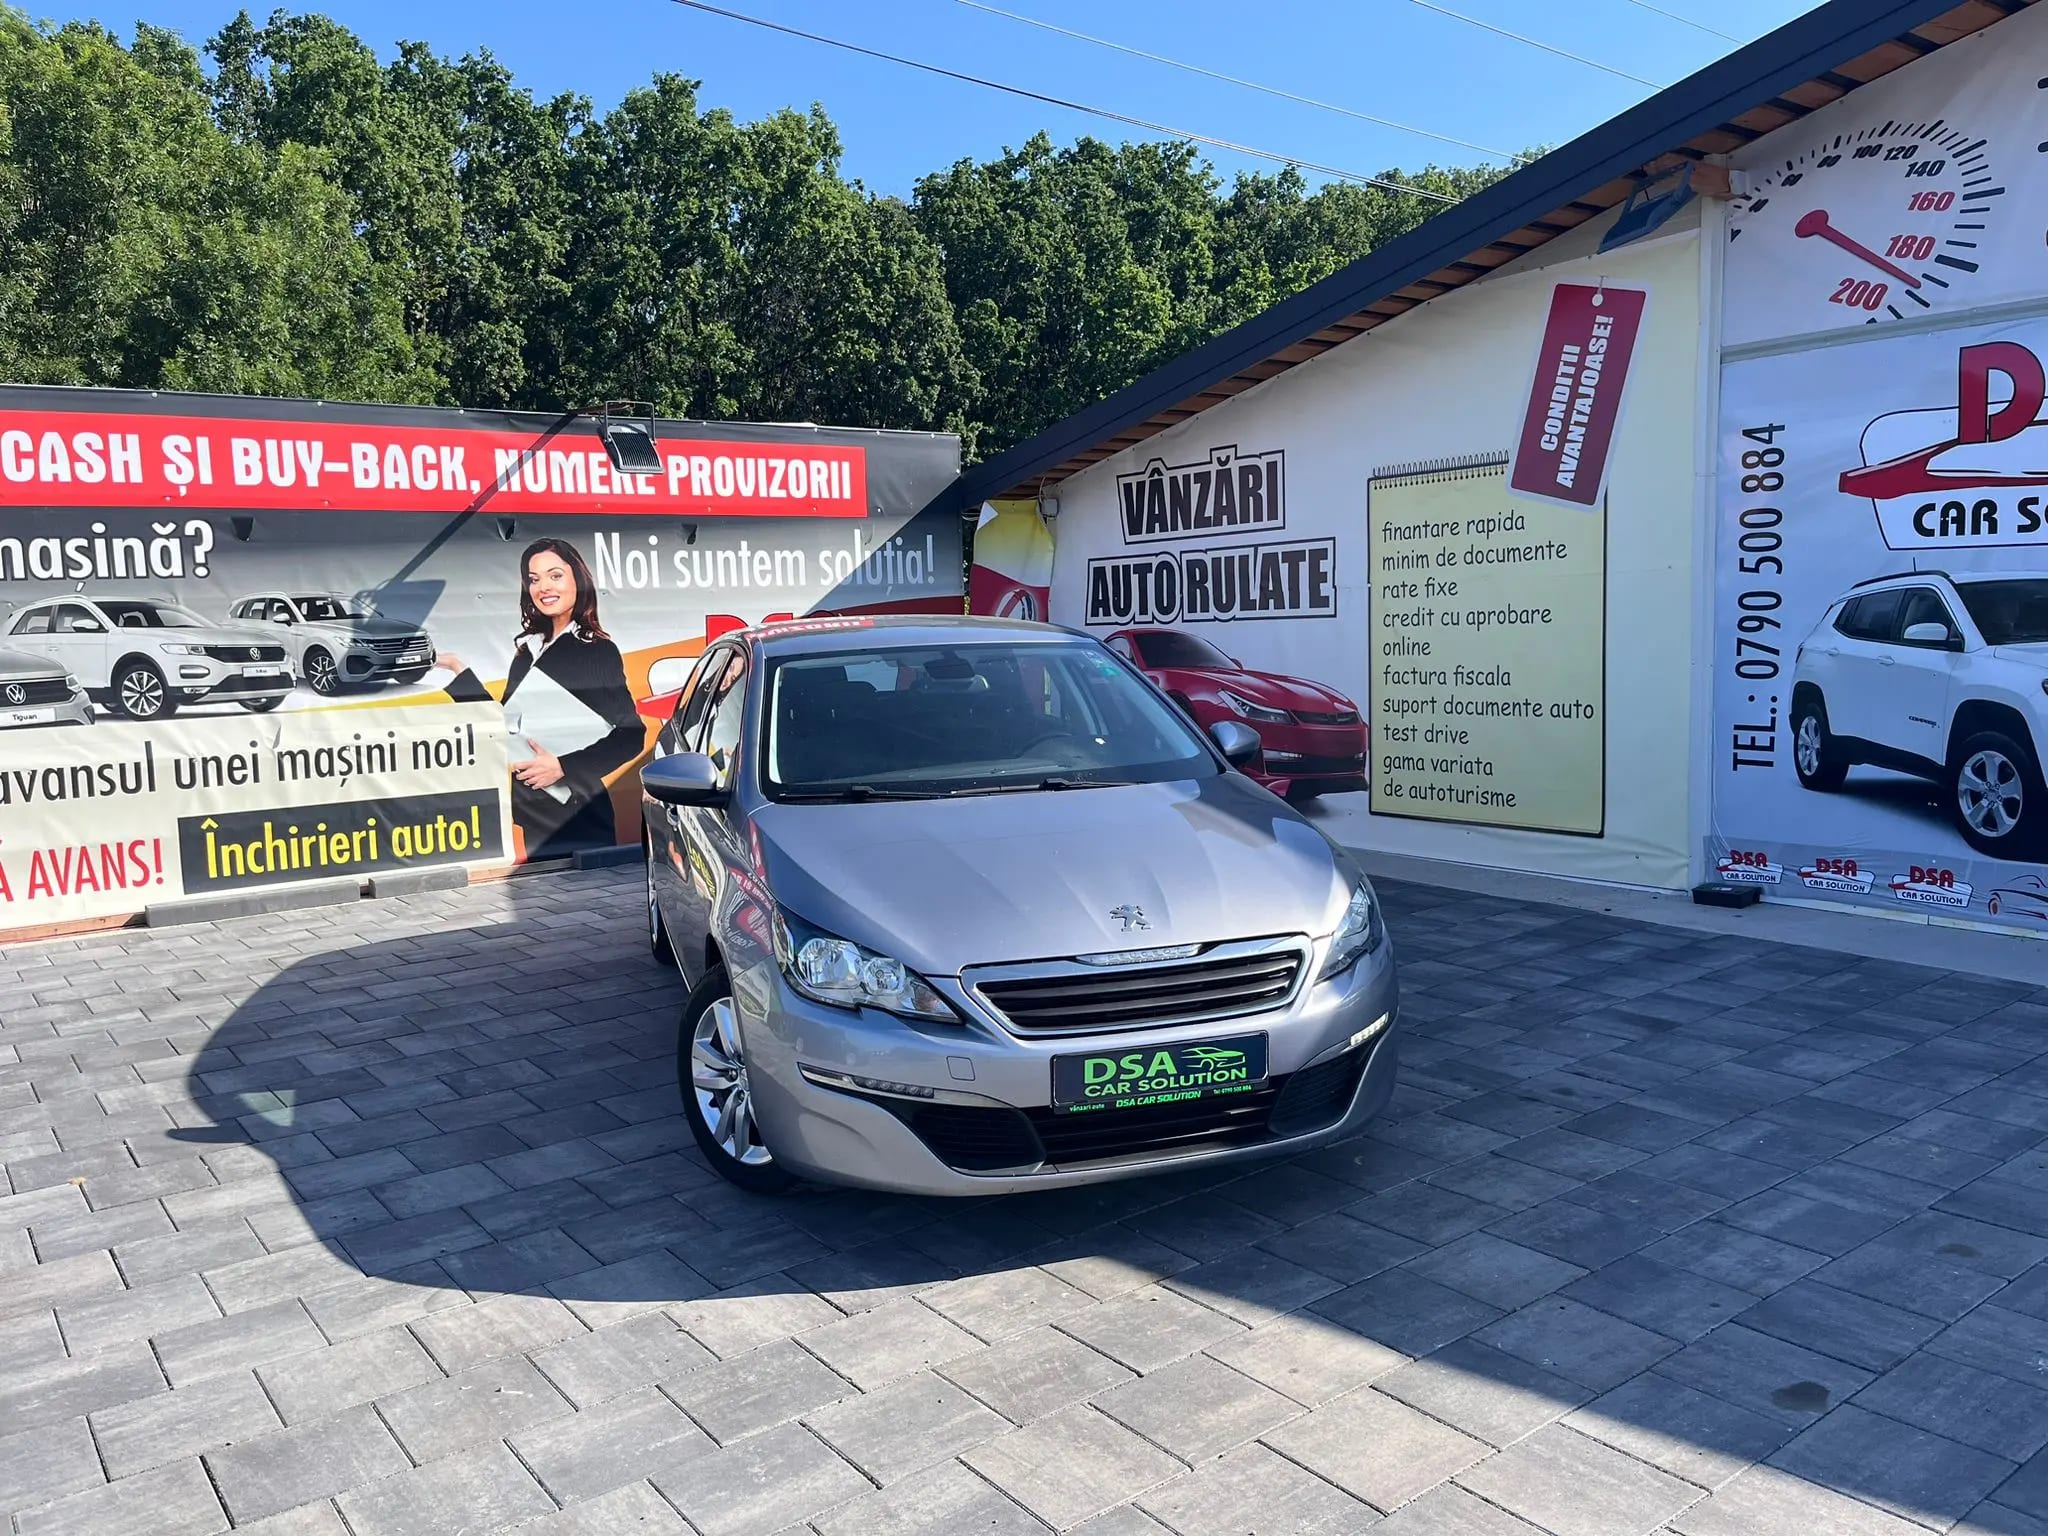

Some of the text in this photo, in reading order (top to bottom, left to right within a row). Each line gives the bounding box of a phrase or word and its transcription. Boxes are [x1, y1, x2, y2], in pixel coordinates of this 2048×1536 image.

[1852, 144, 1883, 159] 100
[1883, 144, 1919, 161] 120
[1904, 160, 1946, 178] 140
[1907, 191, 1956, 212] 160
[1884, 235, 1936, 260] 180
[1828, 277, 1889, 311] 200
[1540, 344, 1581, 452] CONDITII
[1556, 315, 1614, 488] AVANTAJOASE!
[2, 431, 143, 483] CASH
[162, 434, 213, 497] ȘI
[232, 438, 481, 494] BUY-BACK,
[668, 455, 851, 500] PROVIZORII
[1741, 423, 1786, 493] 884
[1122, 455, 1279, 536] VÂNZĂRI
[1382, 510, 1525, 543] finantare rapida
[1913, 499, 1998, 537] CAR
[1739, 507, 1783, 575] 500
[594, 529, 935, 597] Noi suntem soluția!
[1382, 540, 1567, 571] minim de documente
[1091, 548, 1330, 618] AUTO RULATE
[1382, 577, 1458, 599] rate fixe
[1383, 604, 1553, 631] credit cu aprobare
[1383, 636, 1432, 656] online
[1735, 591, 1782, 680] 0790
[1383, 664, 1511, 686] factura fiscala
[12, 713, 37, 723] Tiguan
[1383, 695, 1594, 719] suport documente auto
[1384, 724, 1469, 744] test drive
[174, 741, 260, 790] unei
[278, 731, 397, 788] mașini
[412, 724, 476, 769] noi!
[1383, 755, 1494, 776] gama variata
[1384, 778, 1517, 808] de autoturisme
[201, 805, 482, 879] Închirieri auto!
[28, 838, 165, 899] AVANS!
[1730, 850, 1768, 868] DSA
[1816, 858, 1857, 877] DSA
[1726, 872, 1776, 883] CAR SOLUTION
[1809, 878, 1865, 893] CAR SOLUTION
[1909, 865, 1954, 888] DSA
[1901, 890, 1963, 906] CAR SOLUTION
[1084, 1051, 1177, 1084] DSA
[1084, 1067, 1246, 1098] CAR SOLUTION
[1116, 1090, 1202, 1108] DSA CAR SOLUTION
